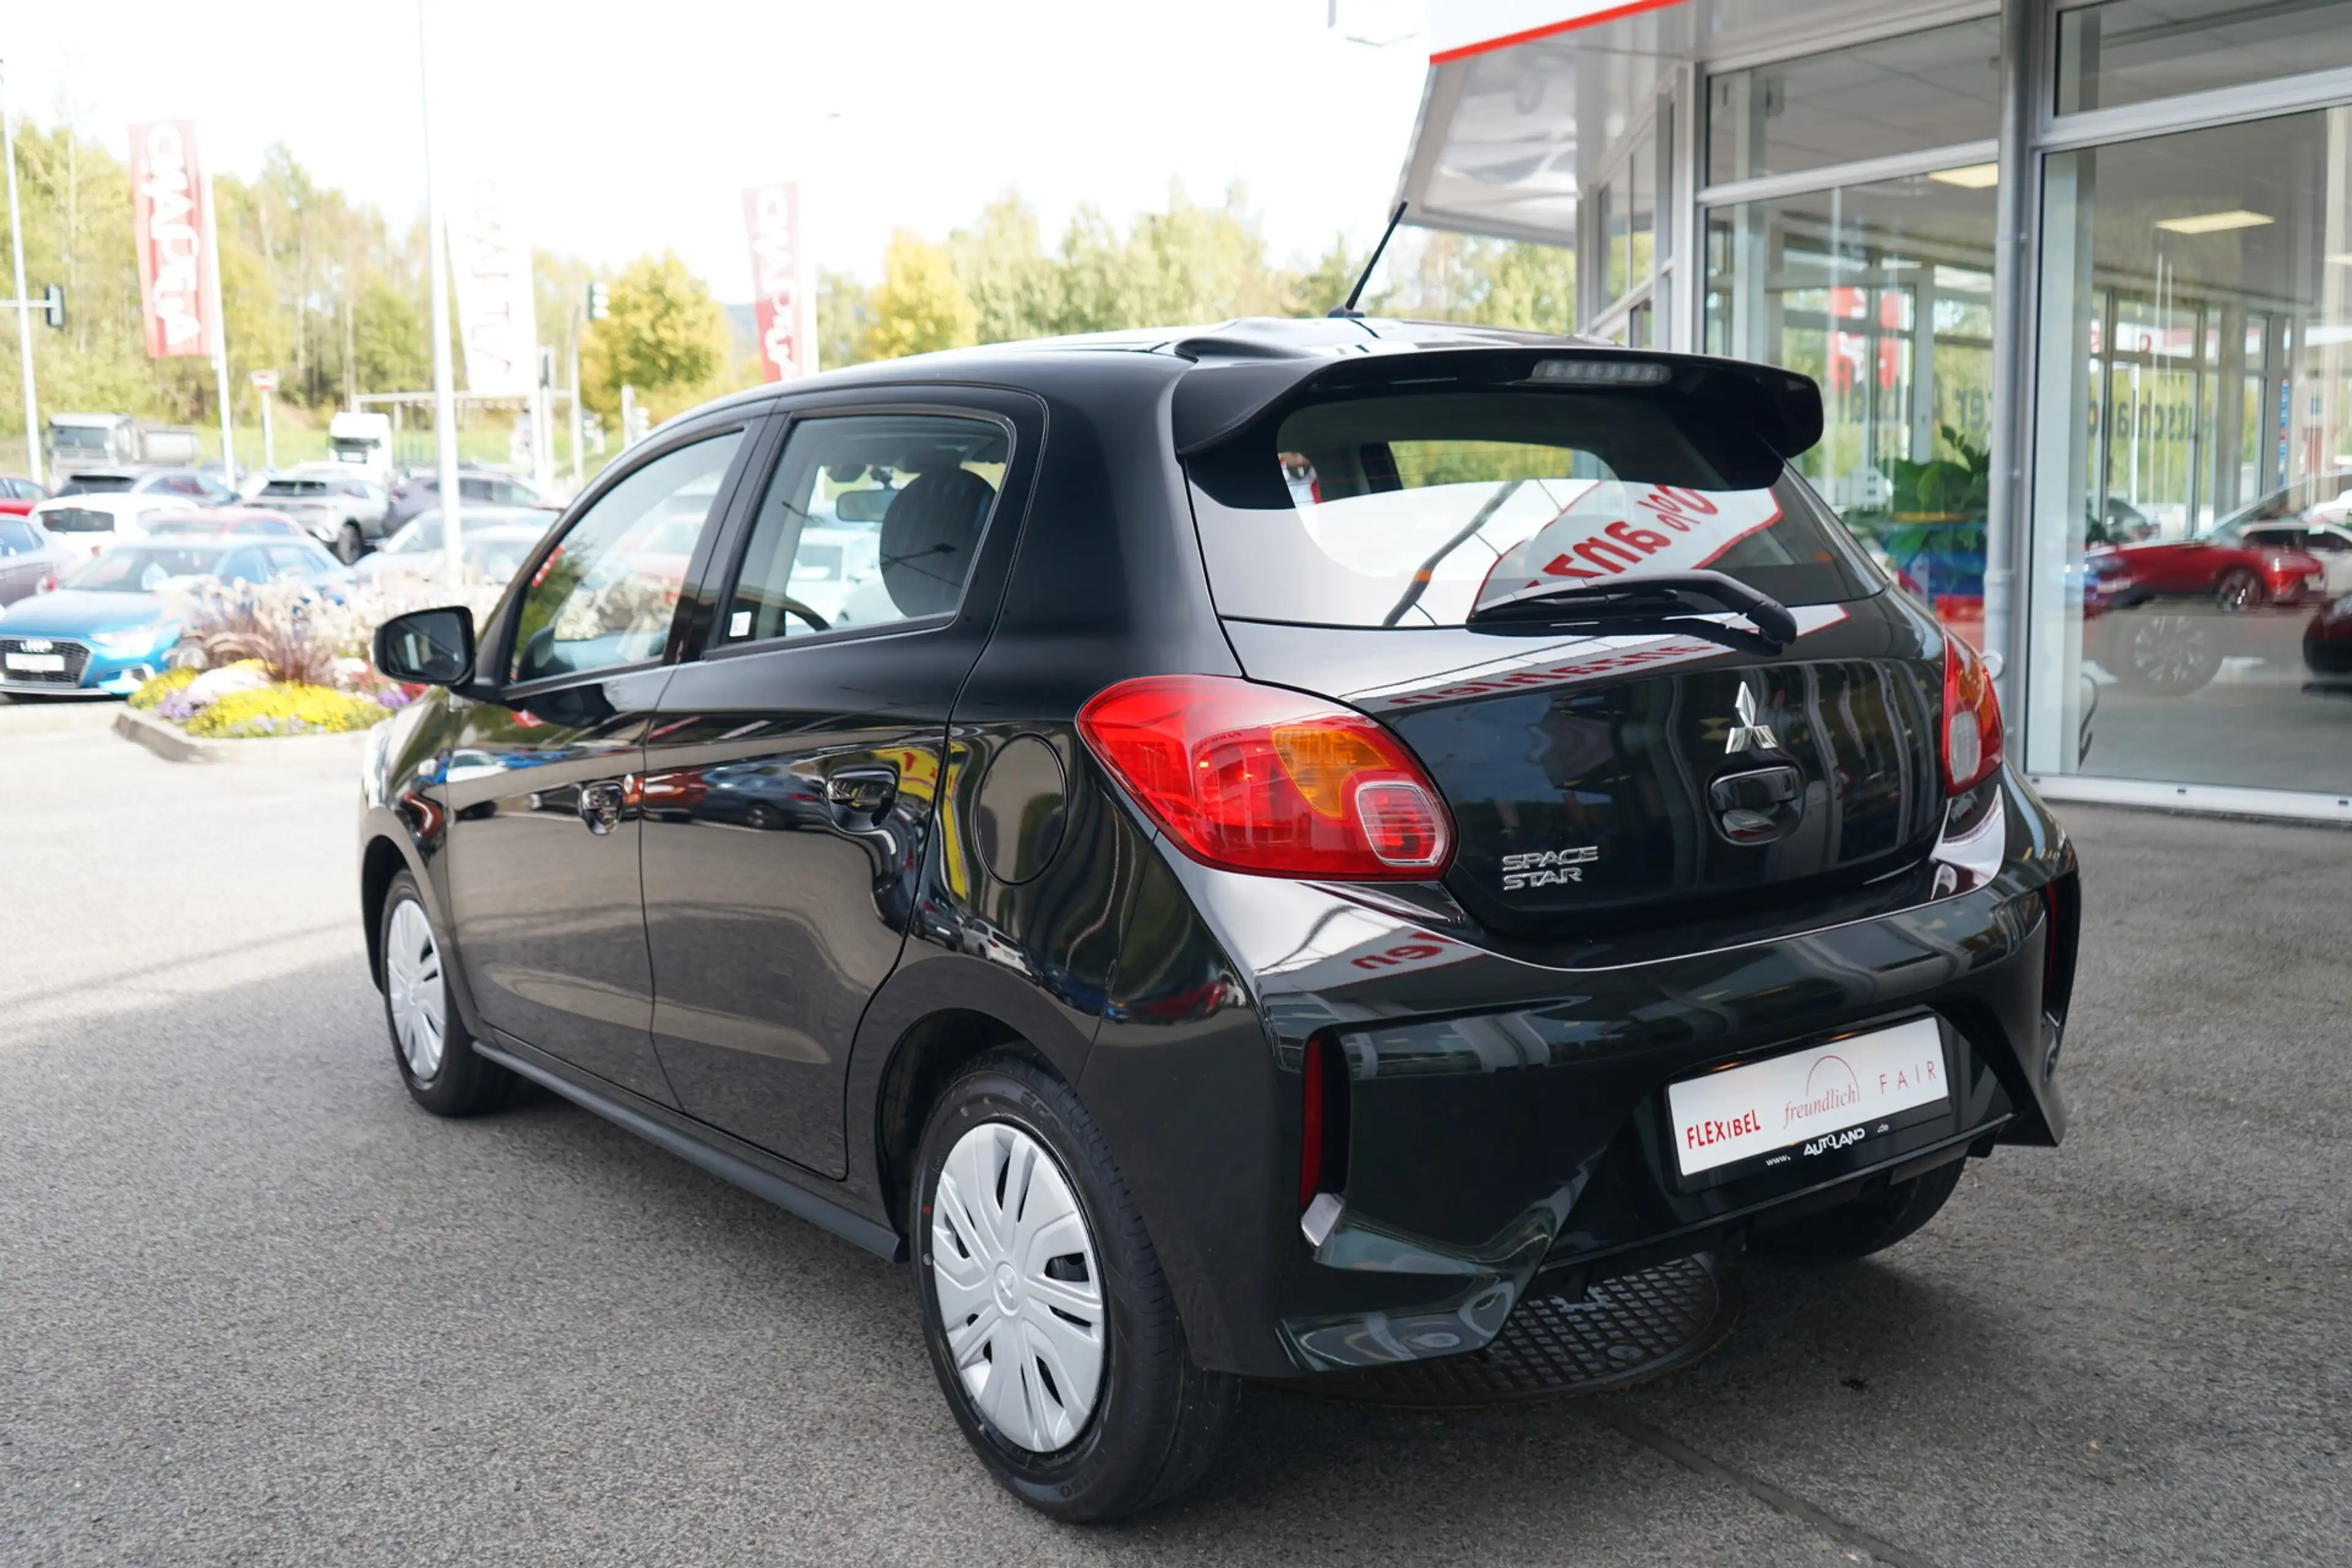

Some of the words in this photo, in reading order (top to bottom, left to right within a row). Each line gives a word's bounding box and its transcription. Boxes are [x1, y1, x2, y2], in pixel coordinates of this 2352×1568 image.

[1502, 846, 1598, 872] SPACE
[1503, 867, 1583, 891] STAR
[1686, 1109, 1762, 1150] FLEXIBEL
[1782, 1084, 1858, 1129] freundlich
[1879, 1060, 1937, 1095] FAIR
[1803, 1128, 1866, 1156] AUTOLAND
